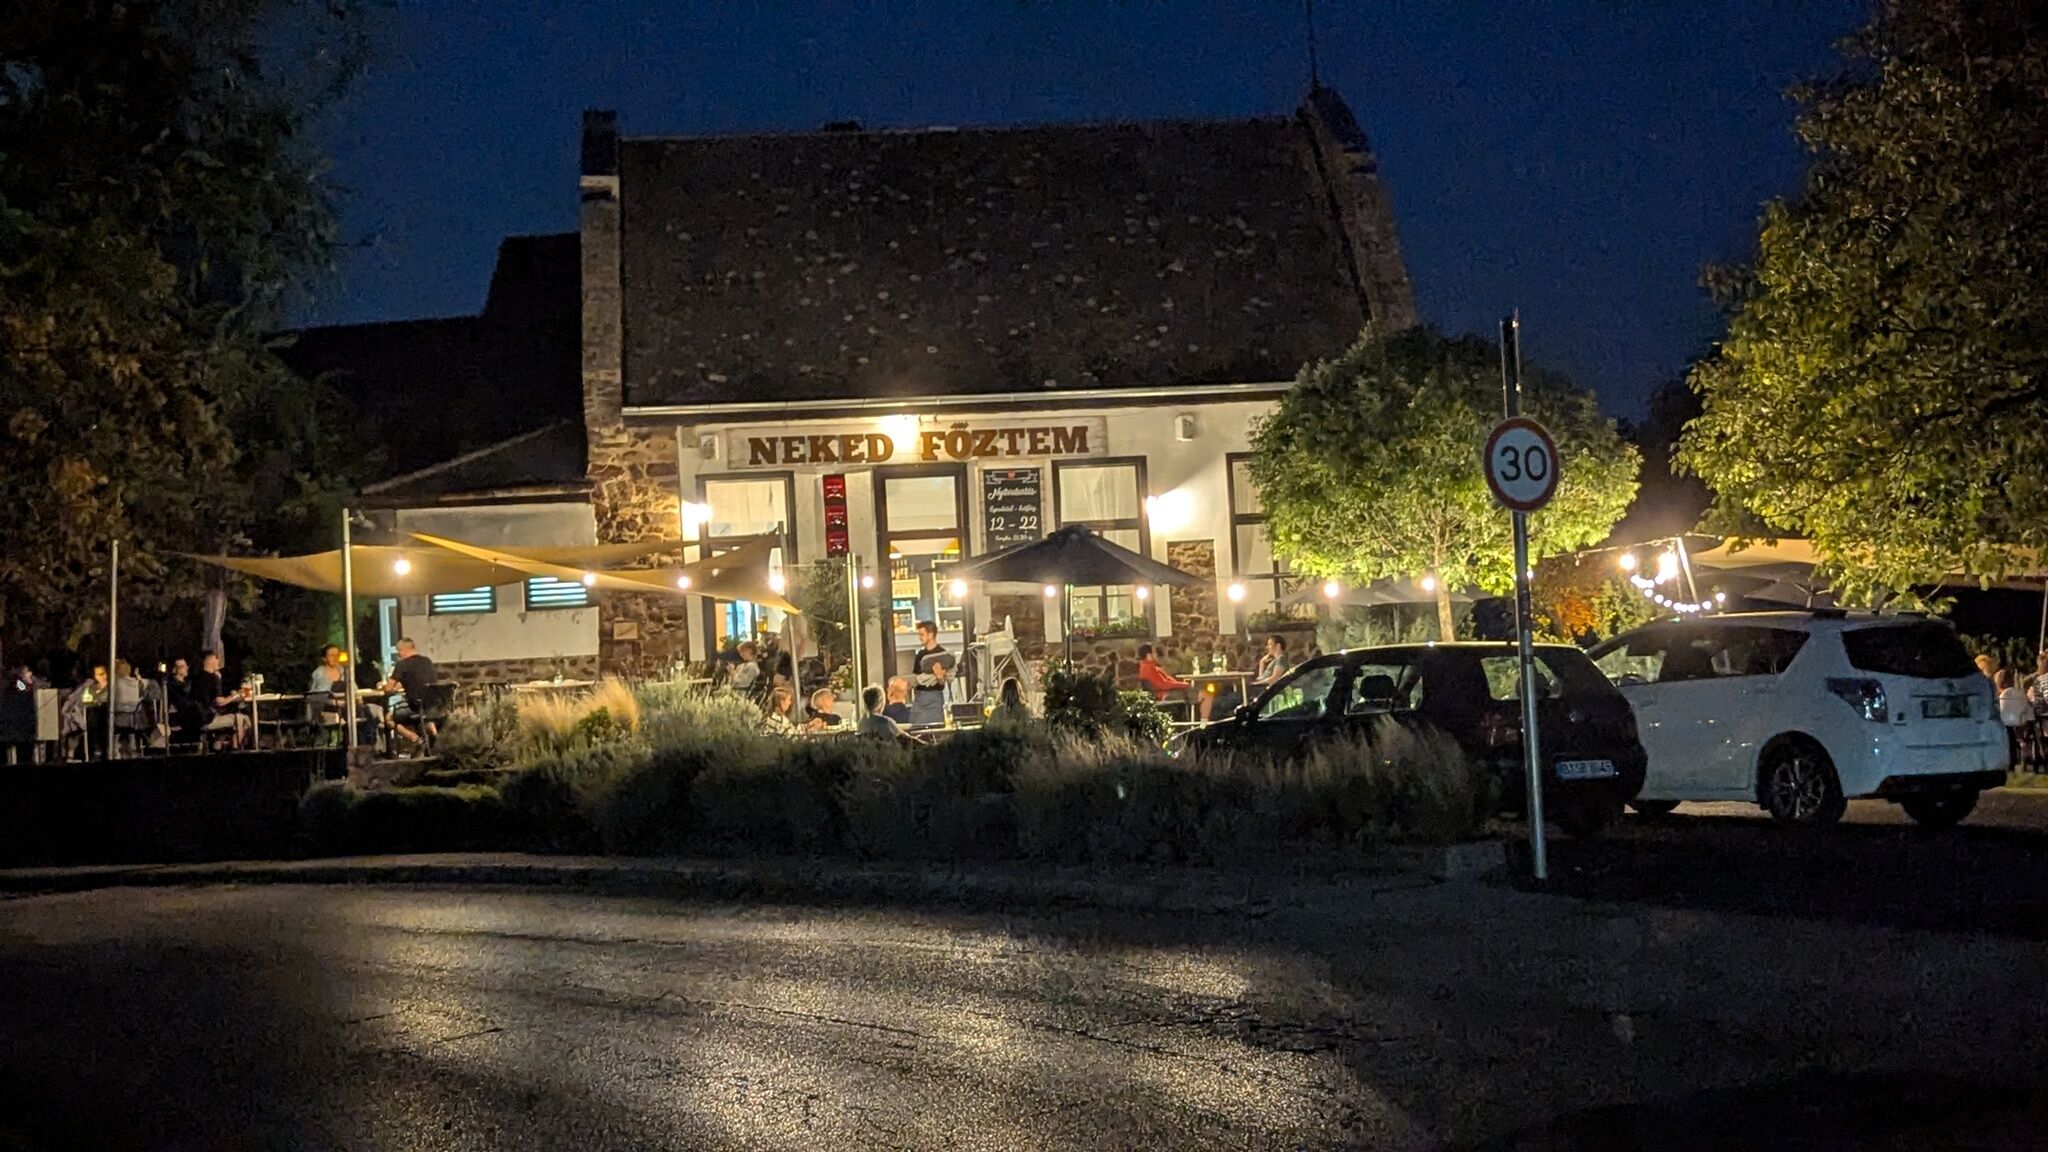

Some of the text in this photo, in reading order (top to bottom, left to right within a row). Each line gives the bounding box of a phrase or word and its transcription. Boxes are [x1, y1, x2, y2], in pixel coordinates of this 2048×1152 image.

[748, 421, 1090, 465] NEKED FŐZTEM
[1500, 445, 1547, 481] 30
[989, 517, 1005, 531] 12
[1019, 516, 1037, 530] 22
